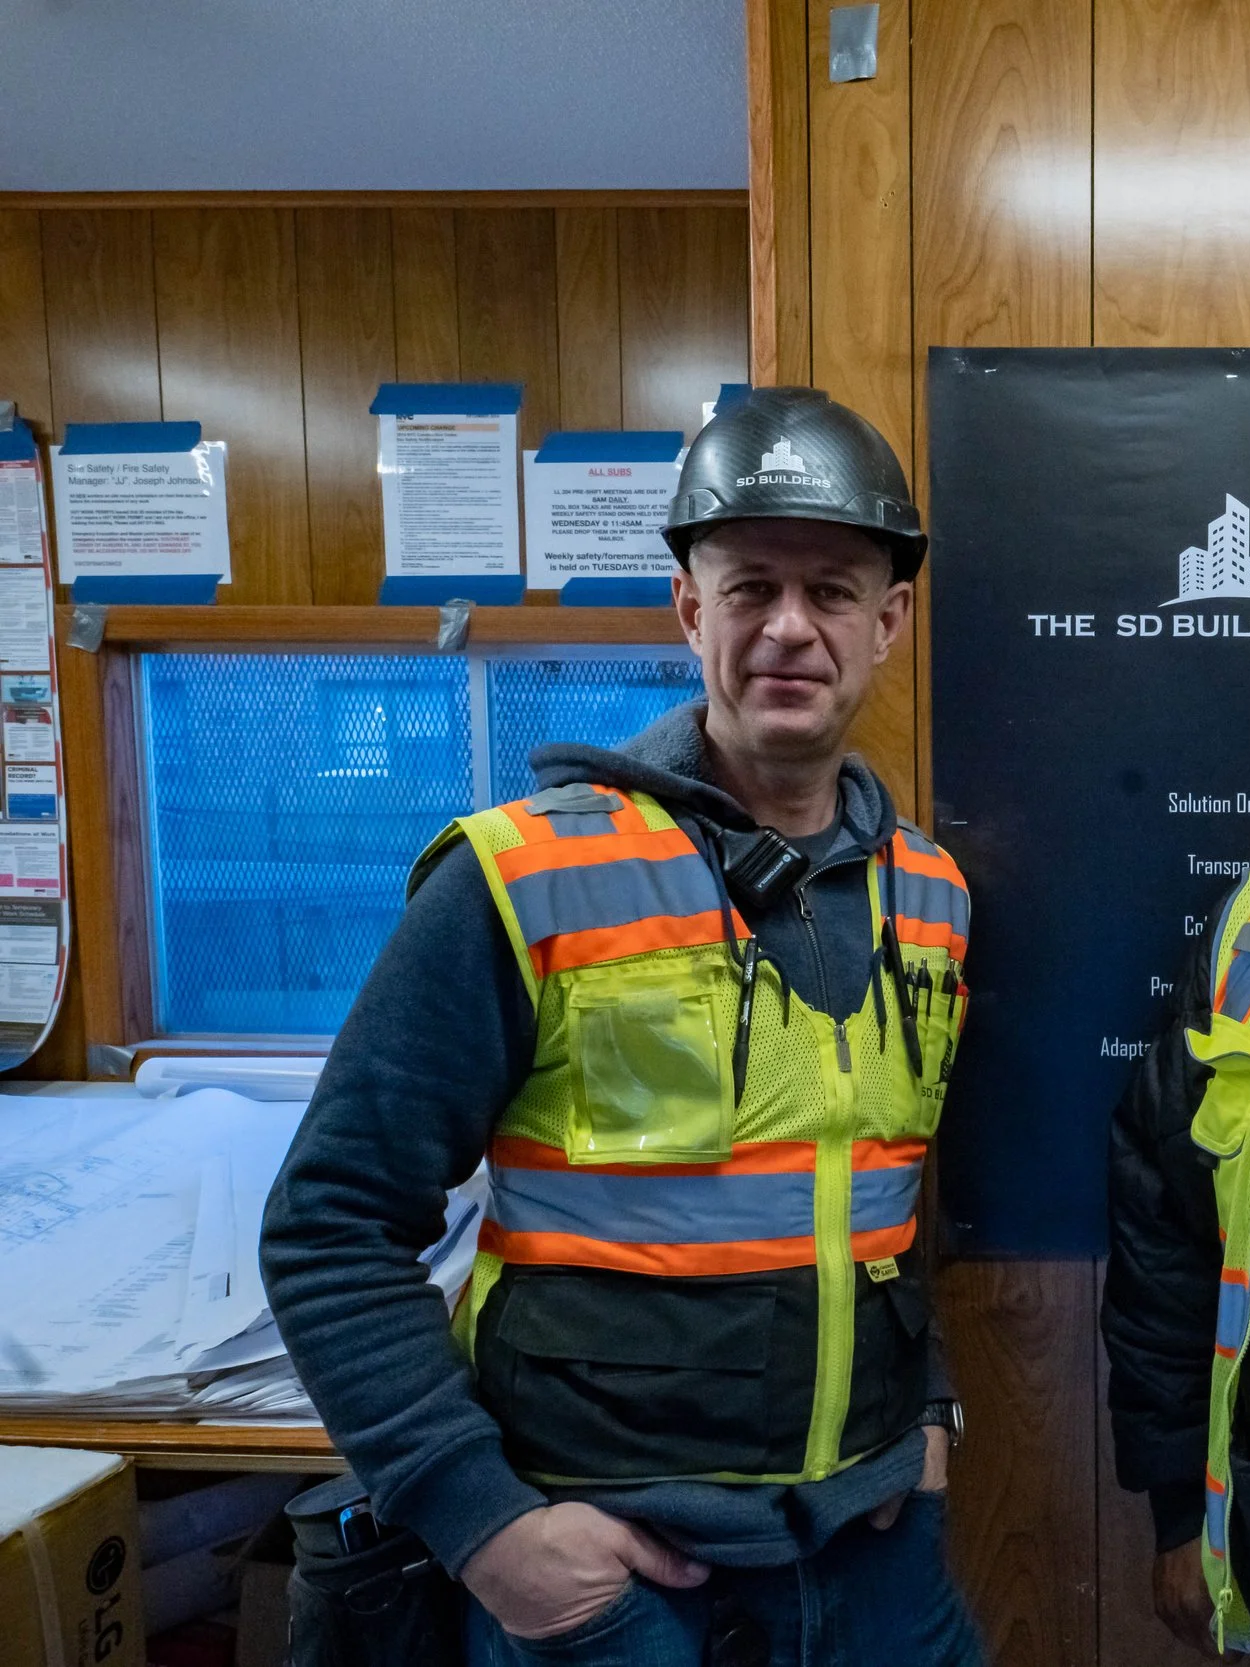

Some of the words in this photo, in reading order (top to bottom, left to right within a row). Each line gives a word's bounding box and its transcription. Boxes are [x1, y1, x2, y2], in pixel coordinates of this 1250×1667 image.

[87, 464, 115, 474] Safety
[122, 464, 140, 473] Fire
[142, 465, 170, 474] Safety
[588, 468, 604, 476] ALL
[607, 468, 632, 476] SUBS
[68, 477, 108, 486] Manager:
[133, 477, 164, 487] Joseph
[736, 476, 756, 487] SD
[759, 475, 831, 488] BUILDERS
[545, 552, 574, 561] Weekly
[576, 552, 644, 561] safety/foremans
[1027, 614, 1095, 636] THE
[1116, 615, 1163, 637] SD
[1169, 792, 1231, 813] Solution
